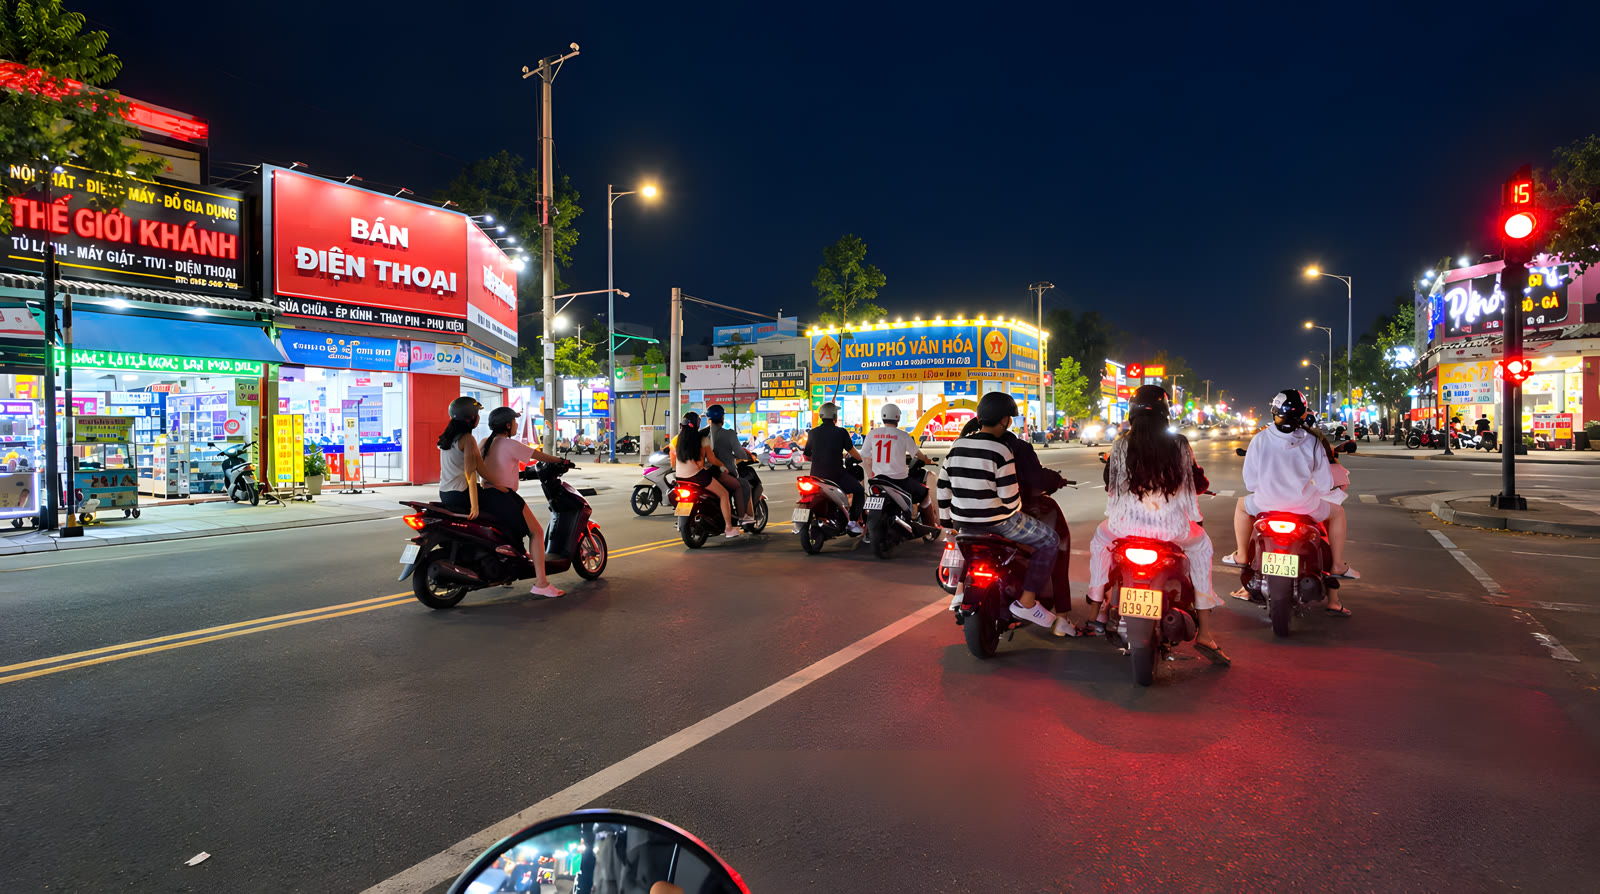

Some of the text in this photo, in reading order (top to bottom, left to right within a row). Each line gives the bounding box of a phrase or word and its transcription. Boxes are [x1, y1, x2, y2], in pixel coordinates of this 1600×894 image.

[128, 185, 155, 204] MÁY
[183, 198, 204, 214] GIA
[206, 203, 237, 221] DỤNG
[1514, 183, 1530, 203] 15
[9, 194, 238, 260] THẾ GIỚI KHÁNH
[351, 216, 409, 249] BÁN
[77, 244, 104, 261] MÁY
[143, 256, 166, 270] TIVI
[203, 264, 236, 282] THOẠI
[295, 245, 366, 281] ĐIỆN
[373, 259, 457, 295] THOẠI
[301, 302, 328, 316] CHỮA
[379, 312, 403, 325] THAY
[404, 315, 420, 327] PIN
[1541, 291, 1560, 309] GÀ
[845, 333, 974, 358] KHU PHỐ VĂN HÓA
[875, 440, 892, 463] 11
